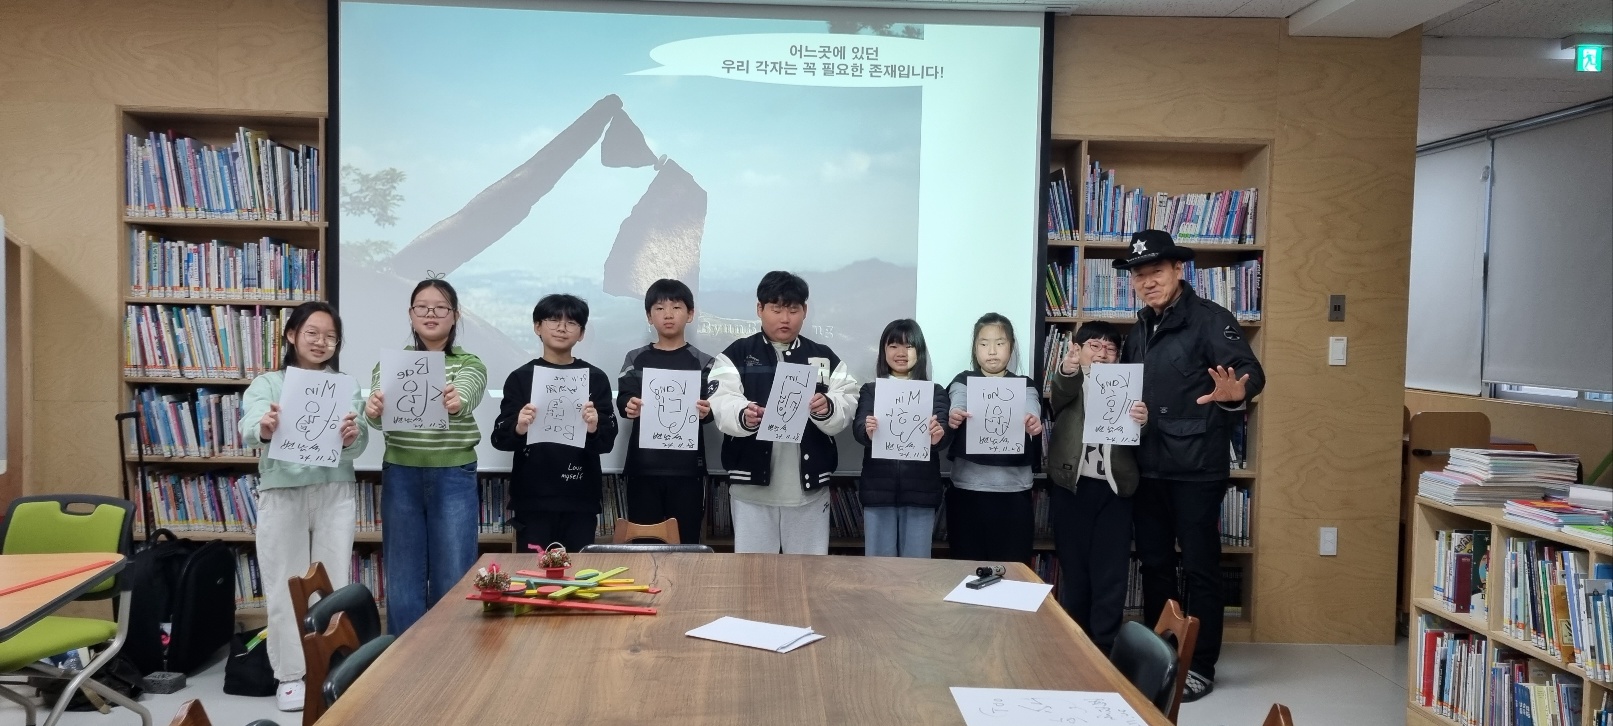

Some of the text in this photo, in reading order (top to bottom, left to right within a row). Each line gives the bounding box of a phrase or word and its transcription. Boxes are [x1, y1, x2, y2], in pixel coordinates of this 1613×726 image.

[789, 44, 879, 61] 어느곳에 있던
[721, 59, 944, 80] 우리 각자는 꼭 필요한 존재입니다!
[567, 462, 583, 471] Love
[561, 472, 583, 481] myself
